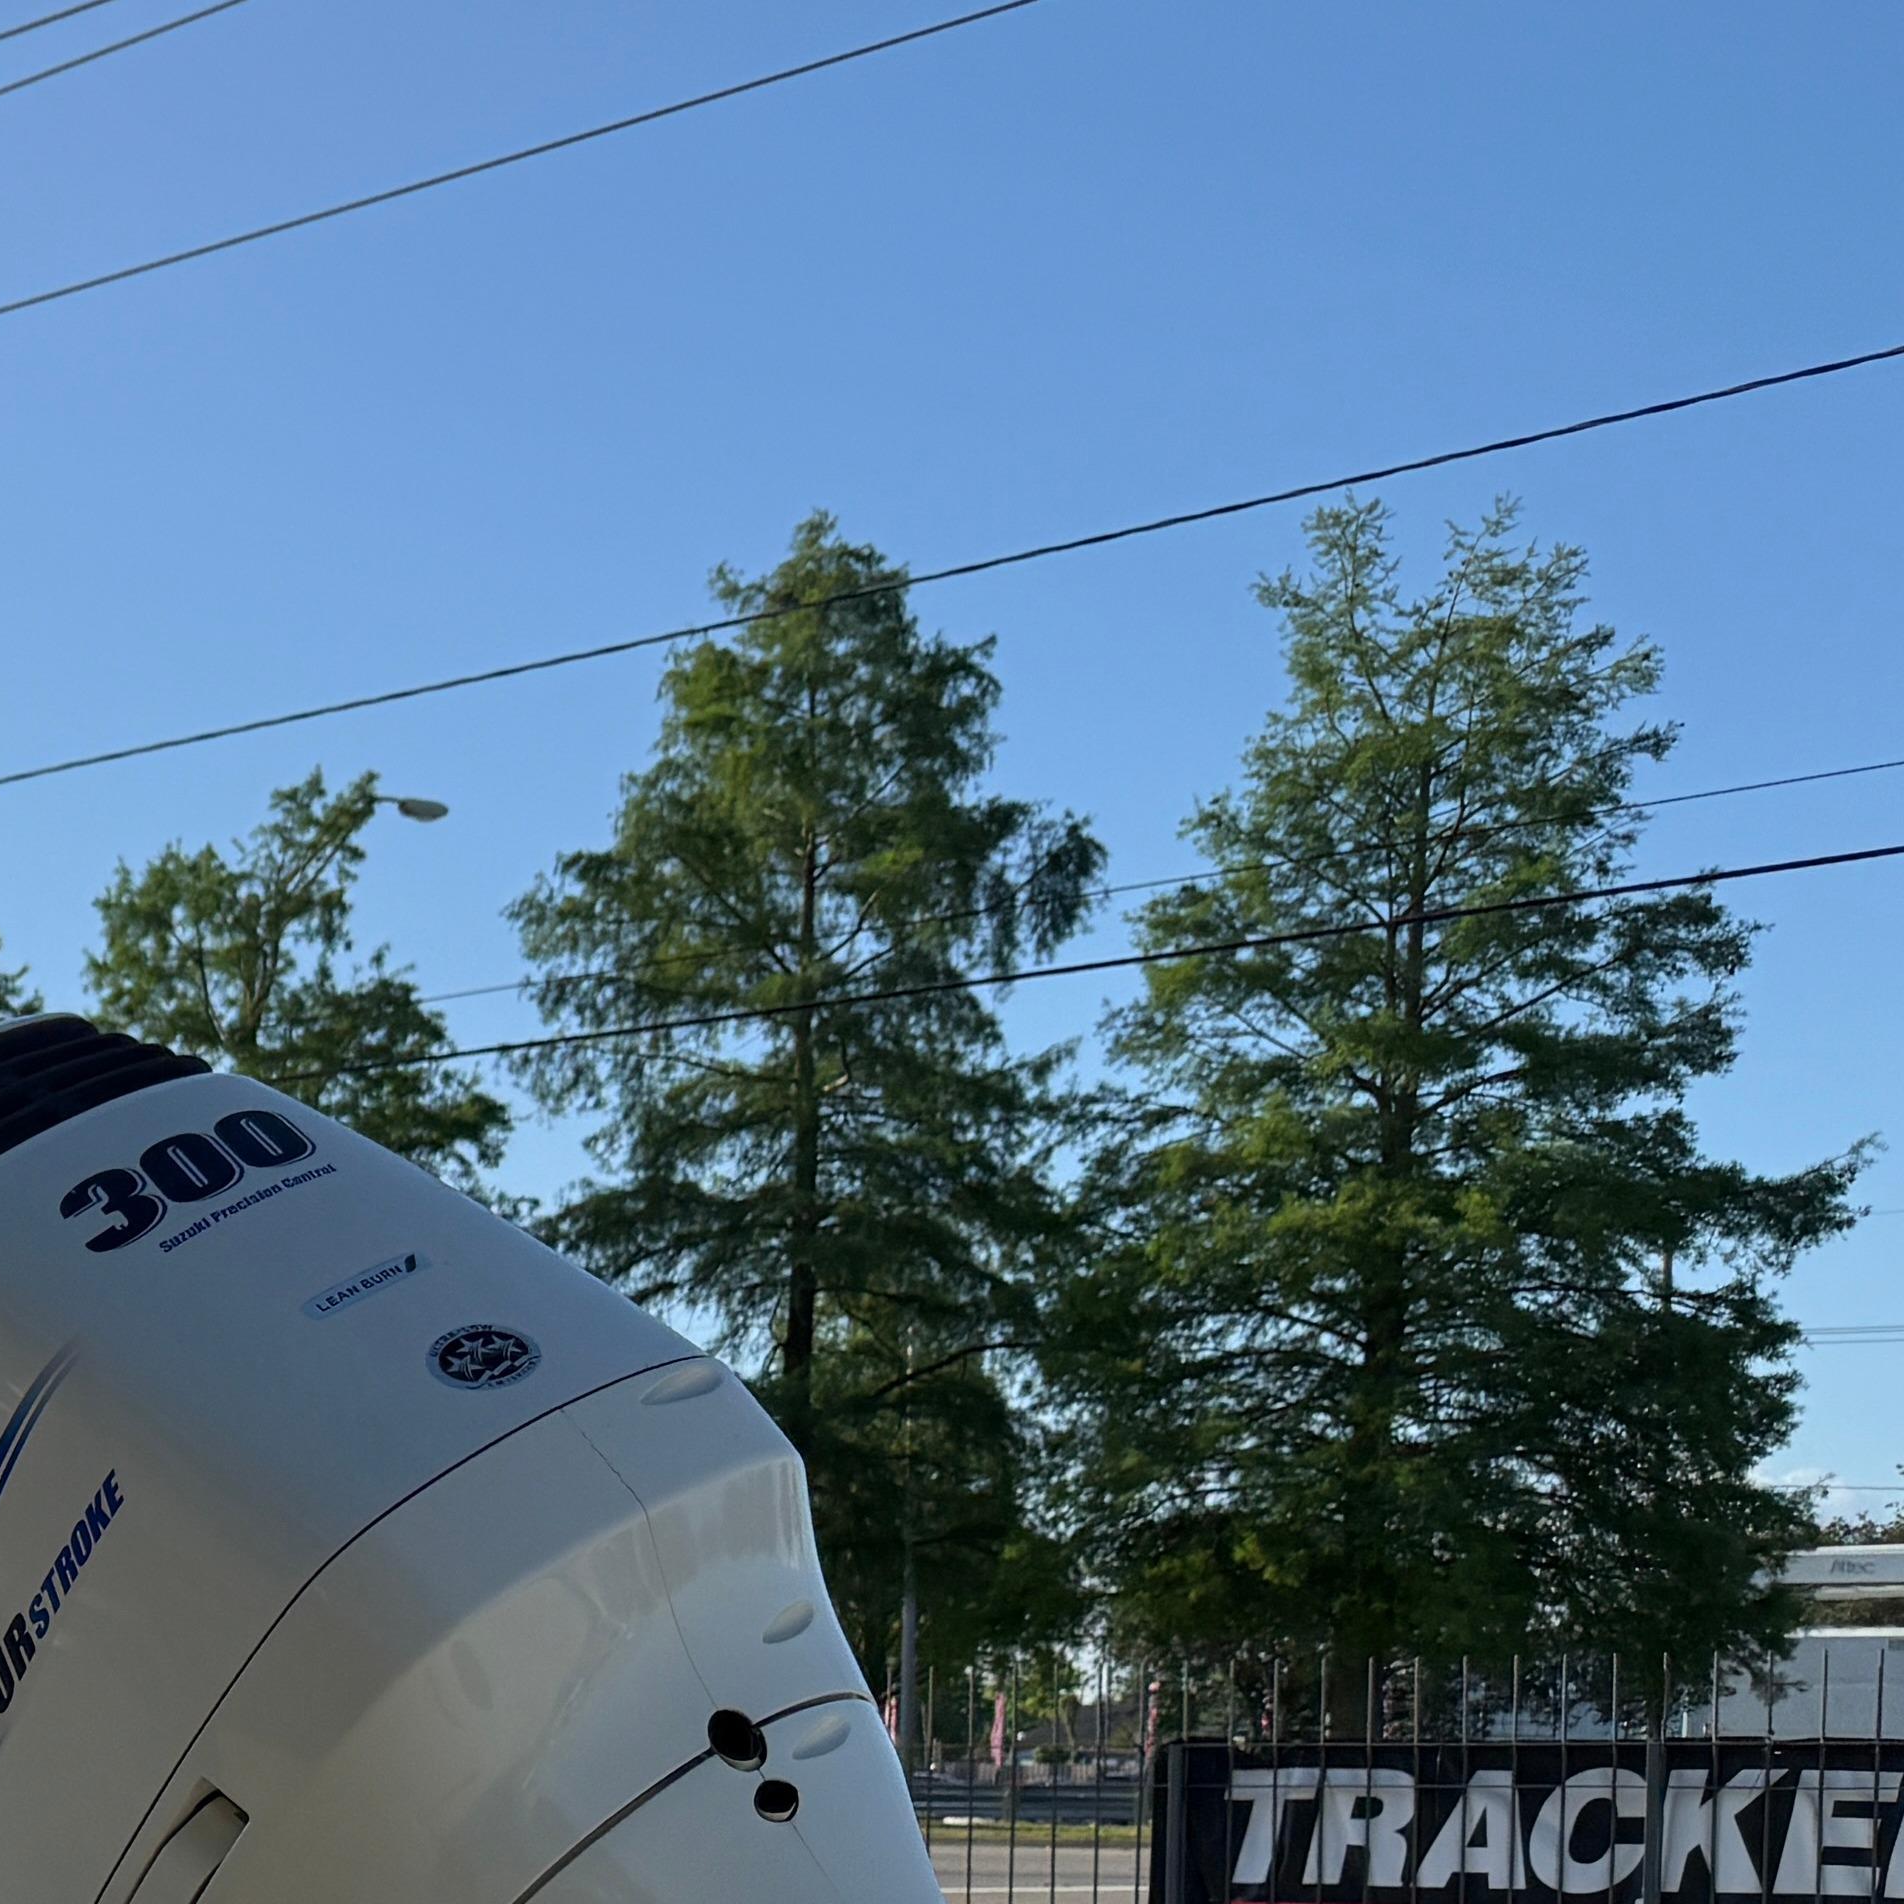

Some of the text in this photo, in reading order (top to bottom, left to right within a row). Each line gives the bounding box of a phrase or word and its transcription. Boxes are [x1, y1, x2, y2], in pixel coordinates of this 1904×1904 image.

[59, 1110, 316, 1253] 300
[159, 1163, 338, 1253] Suzuki Precision Control
[316, 1264, 403, 1312] LEAN BURN
[1225, 1767, 1904, 1899] TRACKE
